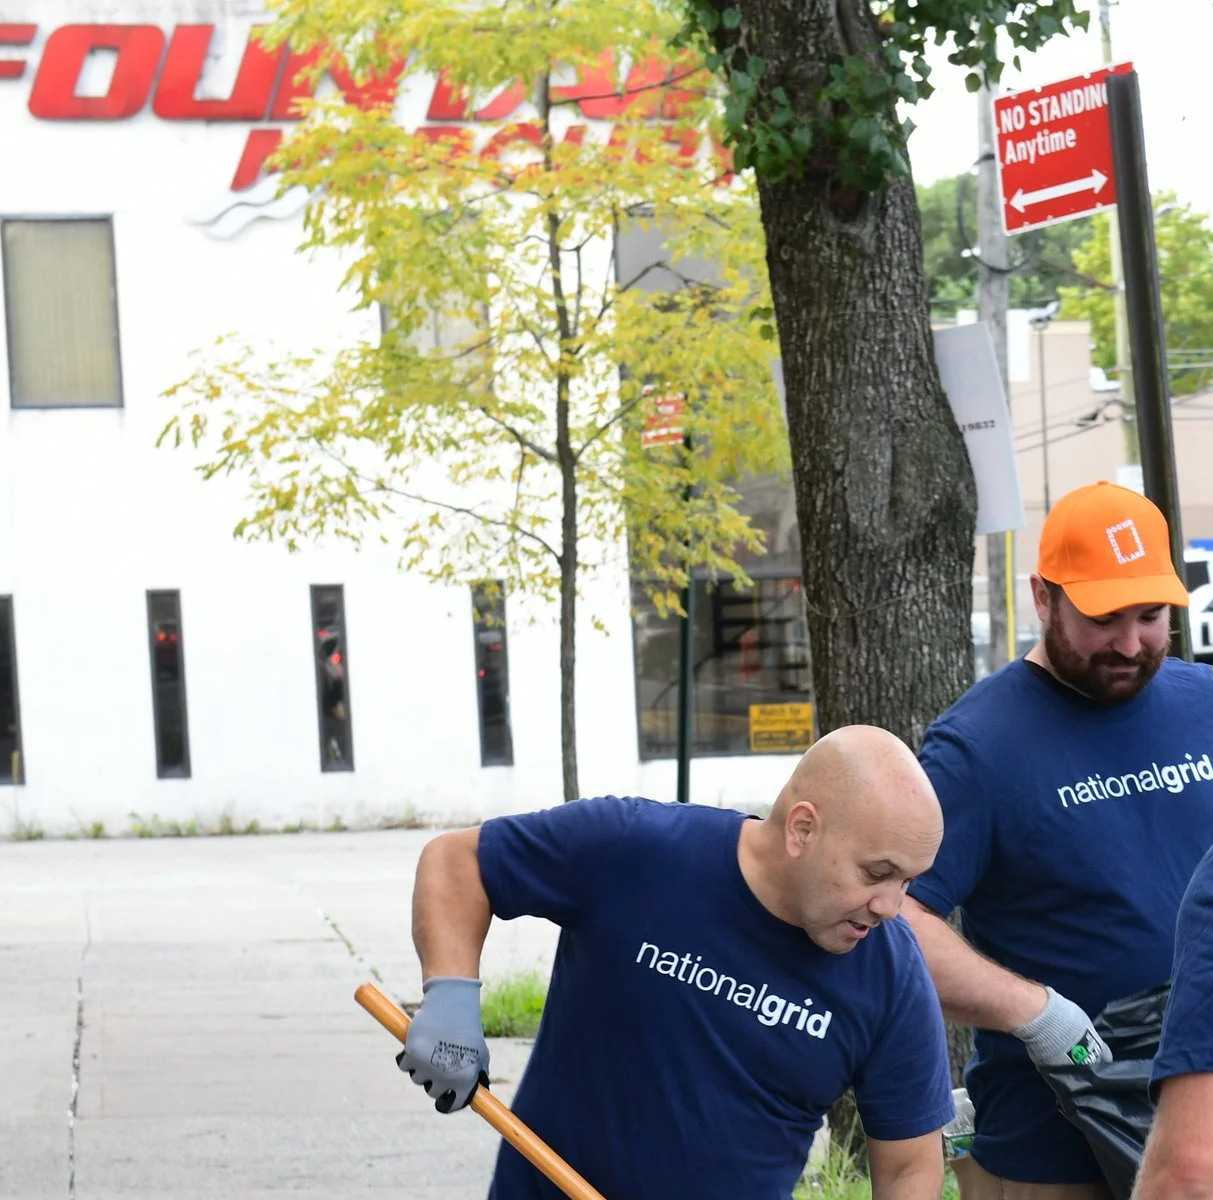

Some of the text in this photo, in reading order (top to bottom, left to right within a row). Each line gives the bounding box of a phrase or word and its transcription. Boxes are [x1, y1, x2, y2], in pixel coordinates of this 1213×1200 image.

[1000, 105, 1026, 135] NO
[1005, 127, 1077, 165] Anytime
[635, 940, 833, 1040] nationalgrid
